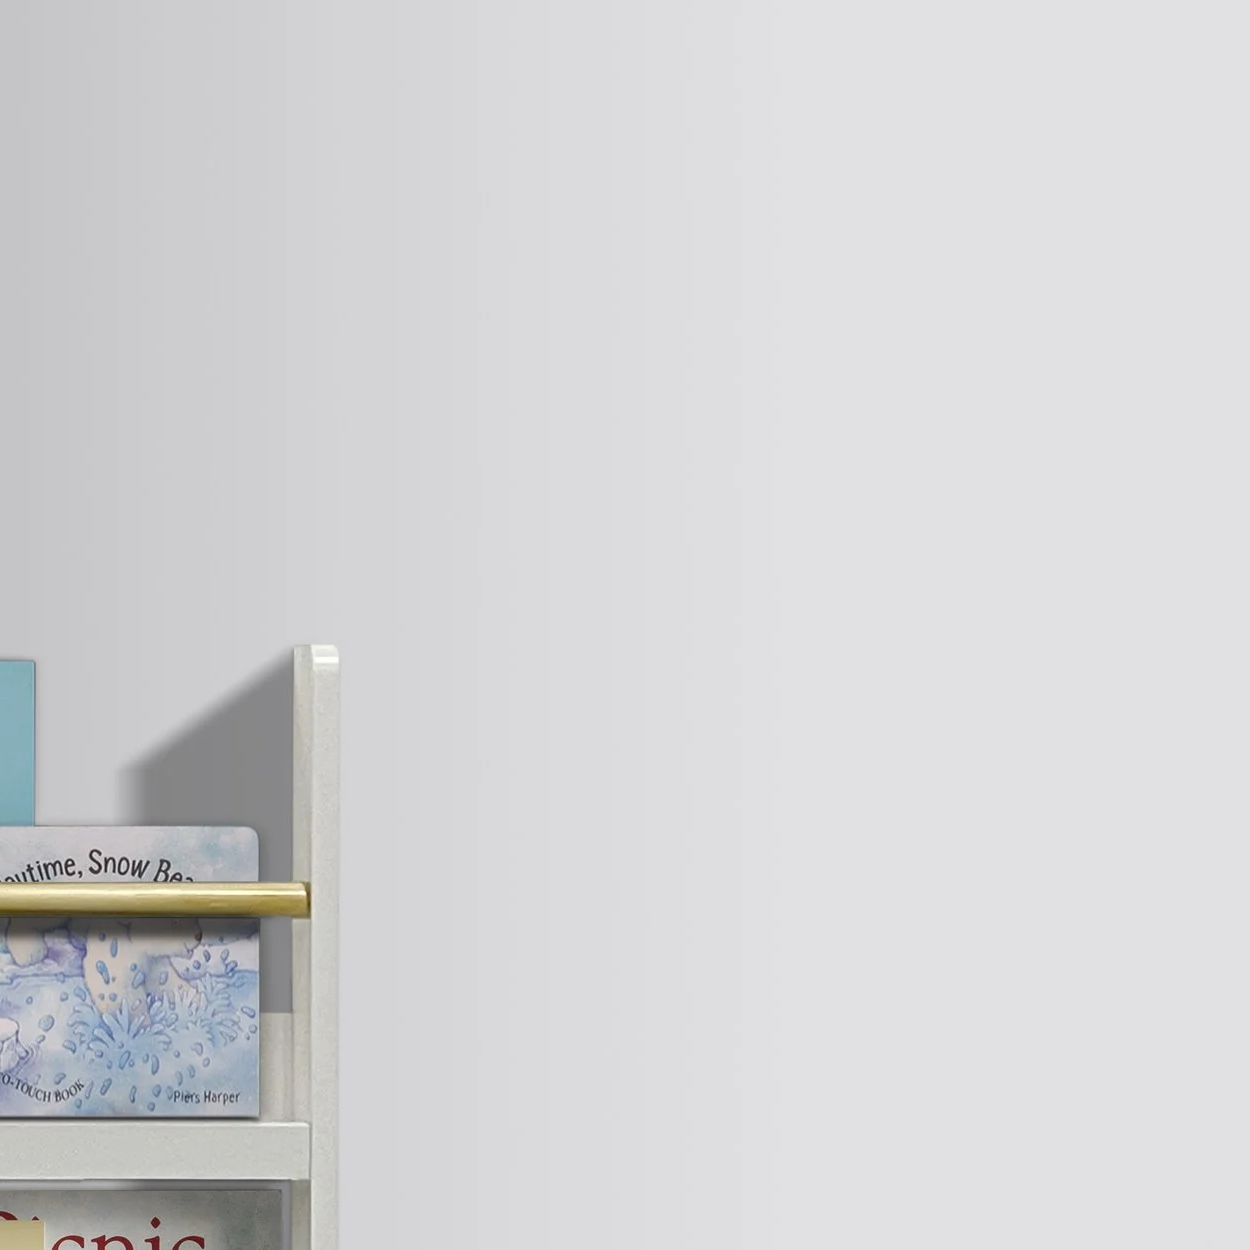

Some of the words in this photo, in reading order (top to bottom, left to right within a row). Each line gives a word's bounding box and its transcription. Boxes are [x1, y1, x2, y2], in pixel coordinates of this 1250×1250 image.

[88, 848, 150, 879] Snow
[153, 858, 194, 882] Be
[53, 1080, 85, 1102] BOOK
[173, 1091, 200, 1104] Piers
[203, 1091, 241, 1104] Harper
